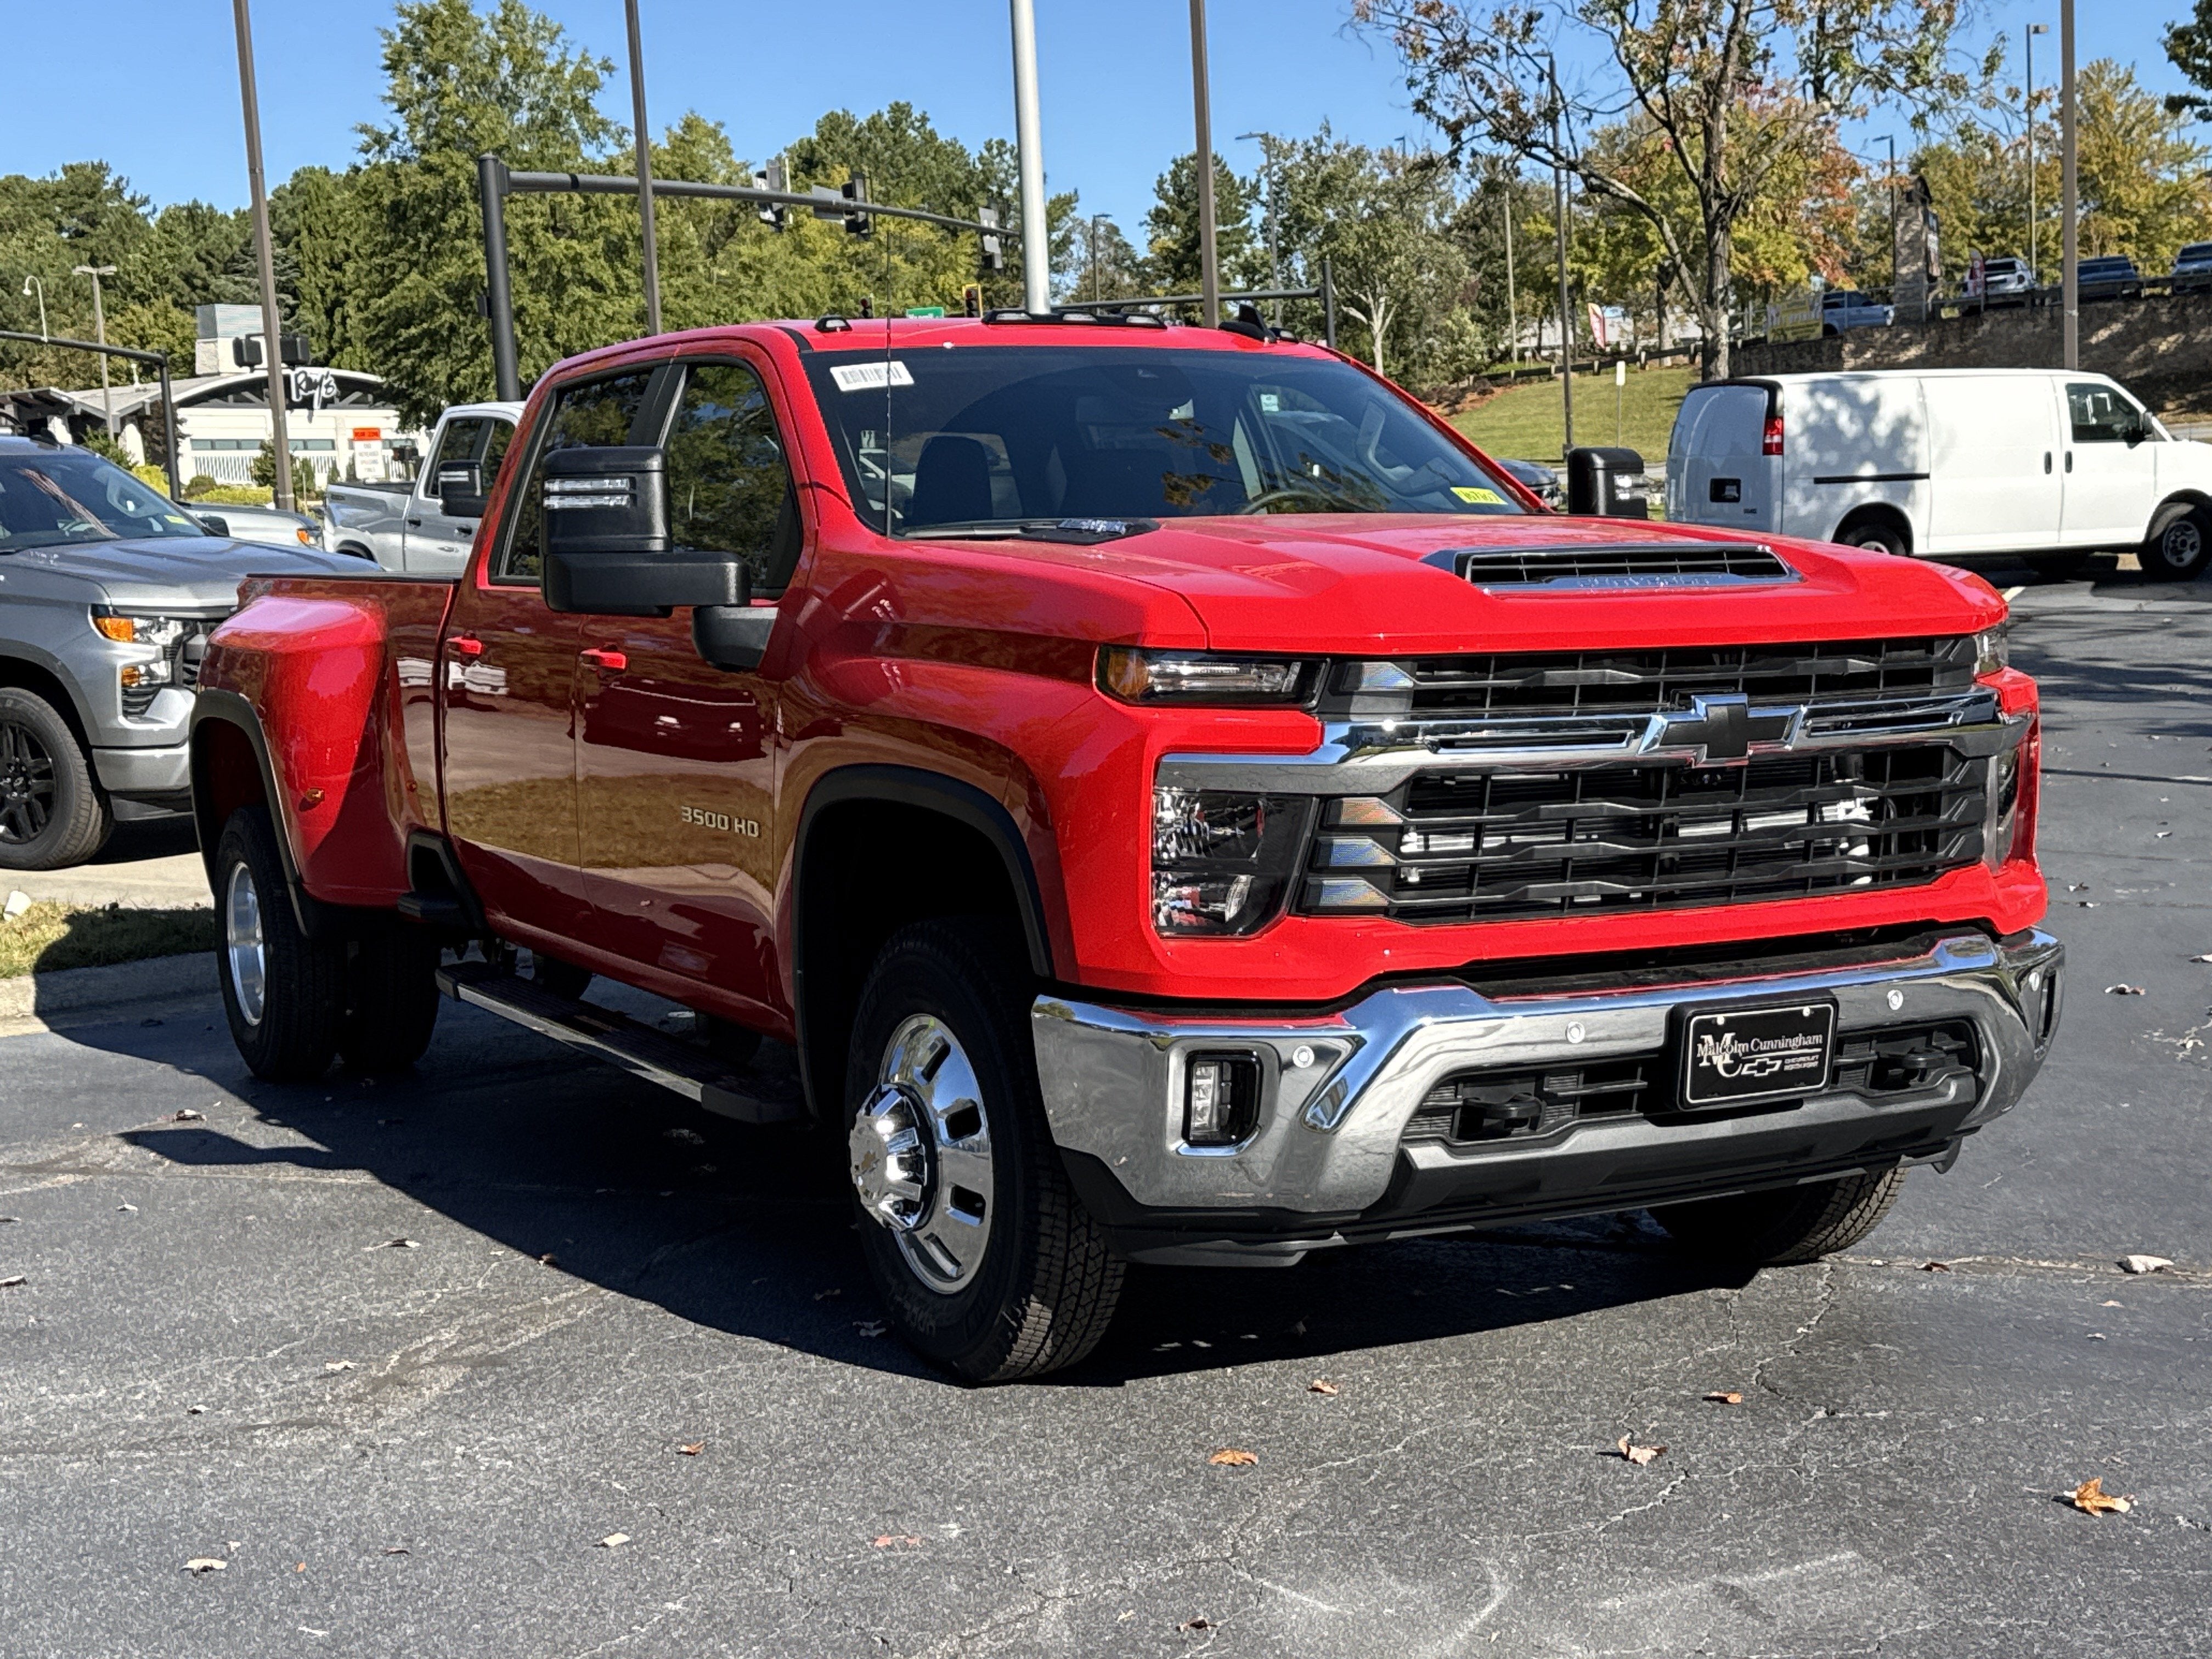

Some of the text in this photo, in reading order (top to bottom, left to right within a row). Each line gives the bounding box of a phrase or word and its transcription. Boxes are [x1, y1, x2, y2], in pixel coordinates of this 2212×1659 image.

[681, 806, 759, 838] 3500 HD
[1697, 1033, 1823, 1058] Malcolm Cunningham
